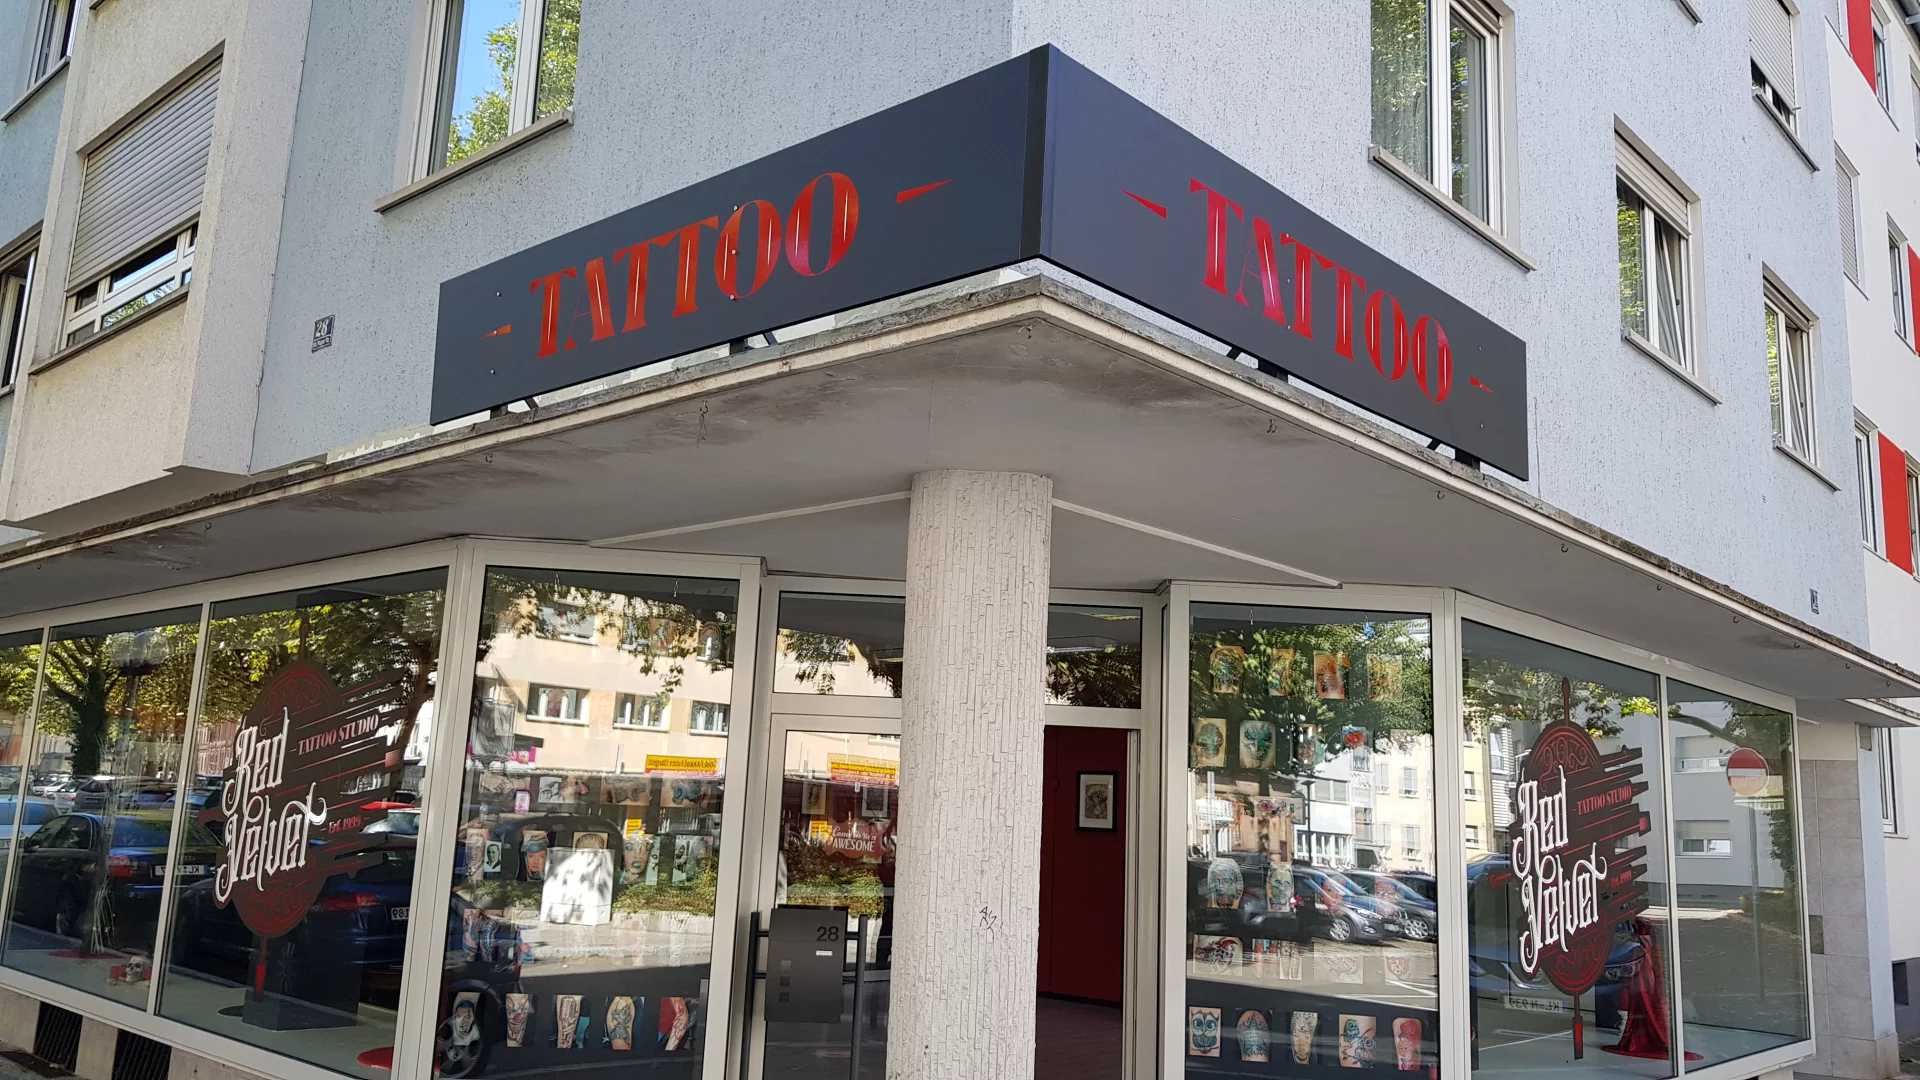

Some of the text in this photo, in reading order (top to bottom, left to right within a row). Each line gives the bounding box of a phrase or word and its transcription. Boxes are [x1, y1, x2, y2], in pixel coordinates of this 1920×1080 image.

[529, 172, 859, 359] TATTOO
[1189, 177, 1453, 403] TATTOO
[316, 319, 330, 337] 28
[221, 706, 290, 822] Red
[298, 714, 379, 756] TATTOO STUDIO
[215, 782, 327, 903] Velvet
[833, 837, 876, 852] AWESOME
[1512, 765, 1569, 882] Red
[1577, 785, 1632, 815] TATTOO STUDIO
[816, 926, 840, 942] 28
[1520, 842, 1608, 974] Velvet
